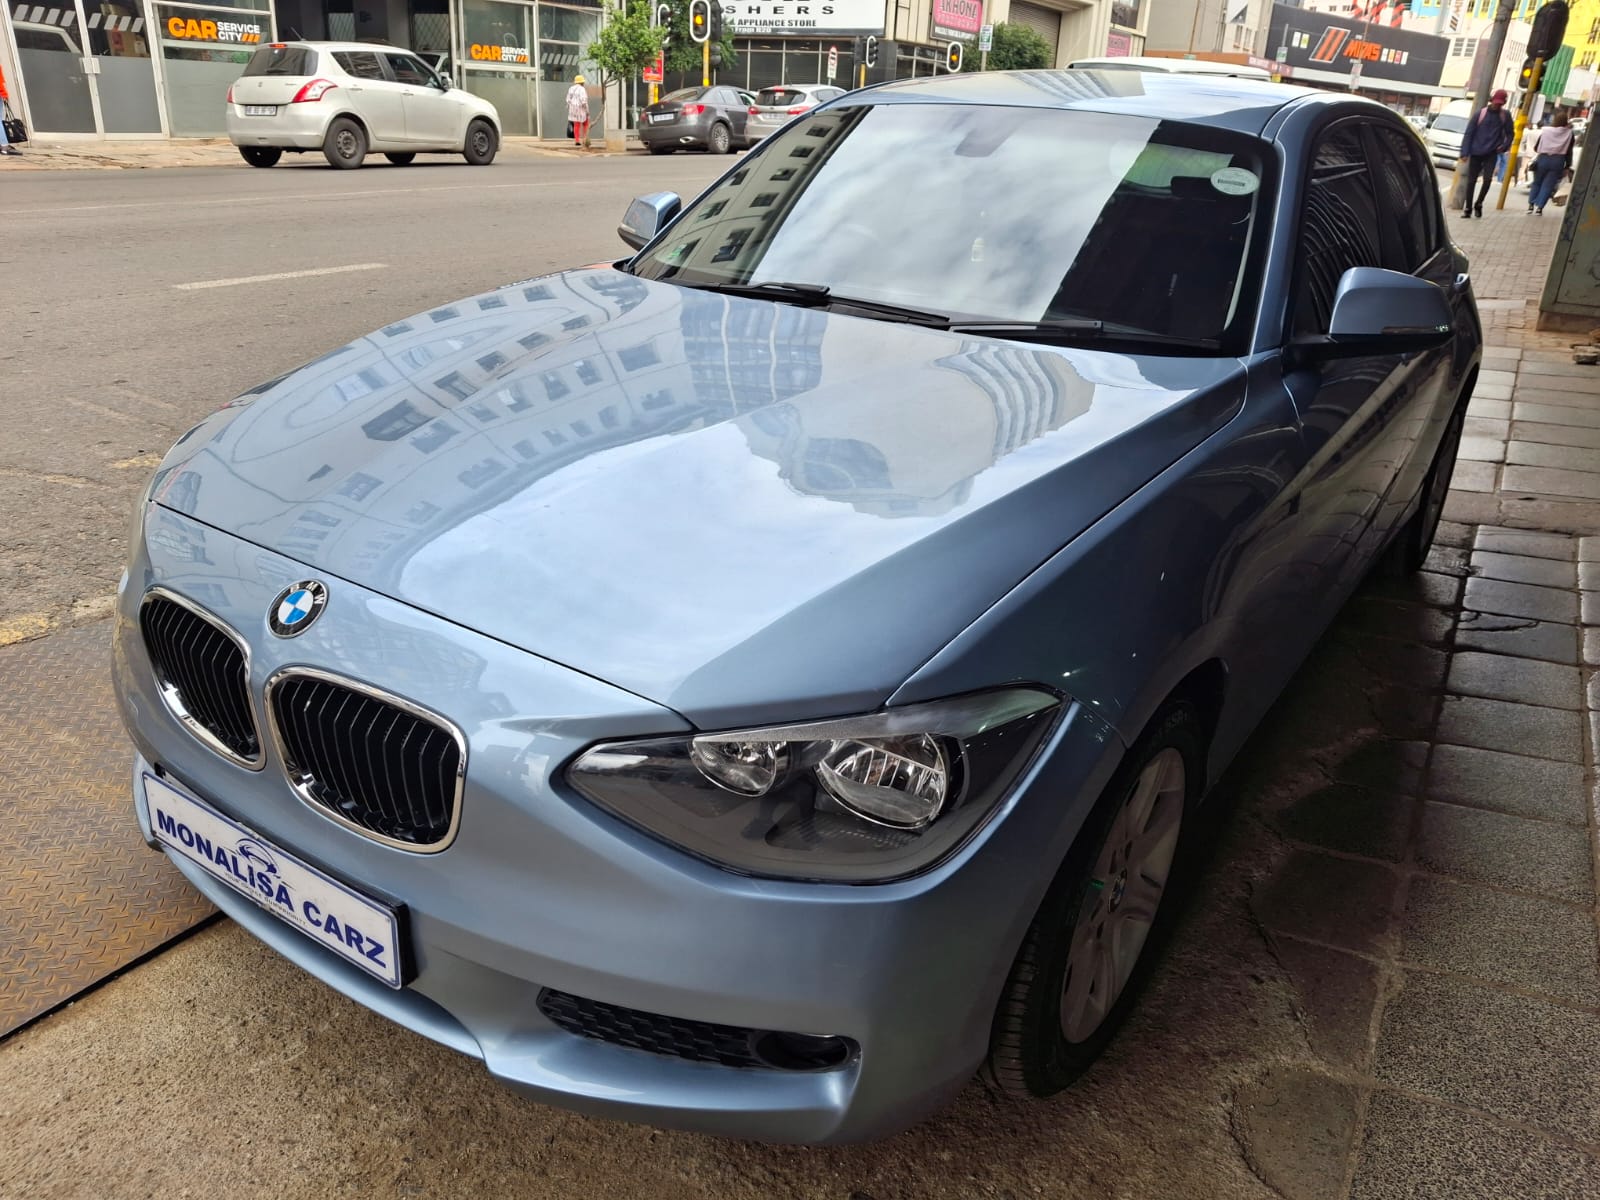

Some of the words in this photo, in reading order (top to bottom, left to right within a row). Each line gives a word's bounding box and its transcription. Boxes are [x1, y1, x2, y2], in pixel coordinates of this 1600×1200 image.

[168, 17, 218, 39] CAR
[217, 22, 260, 33] SERVICE
[737, 18, 785, 27] APPLIANCE
[787, 19, 817, 27] STORE
[218, 32, 243, 41] CITY
[470, 44, 501, 61] CAR
[501, 46, 529, 56] SERVICE
[290, 581, 325, 604] BMW
[156, 808, 295, 912] MONALISA
[303, 901, 387, 969] CARZ
